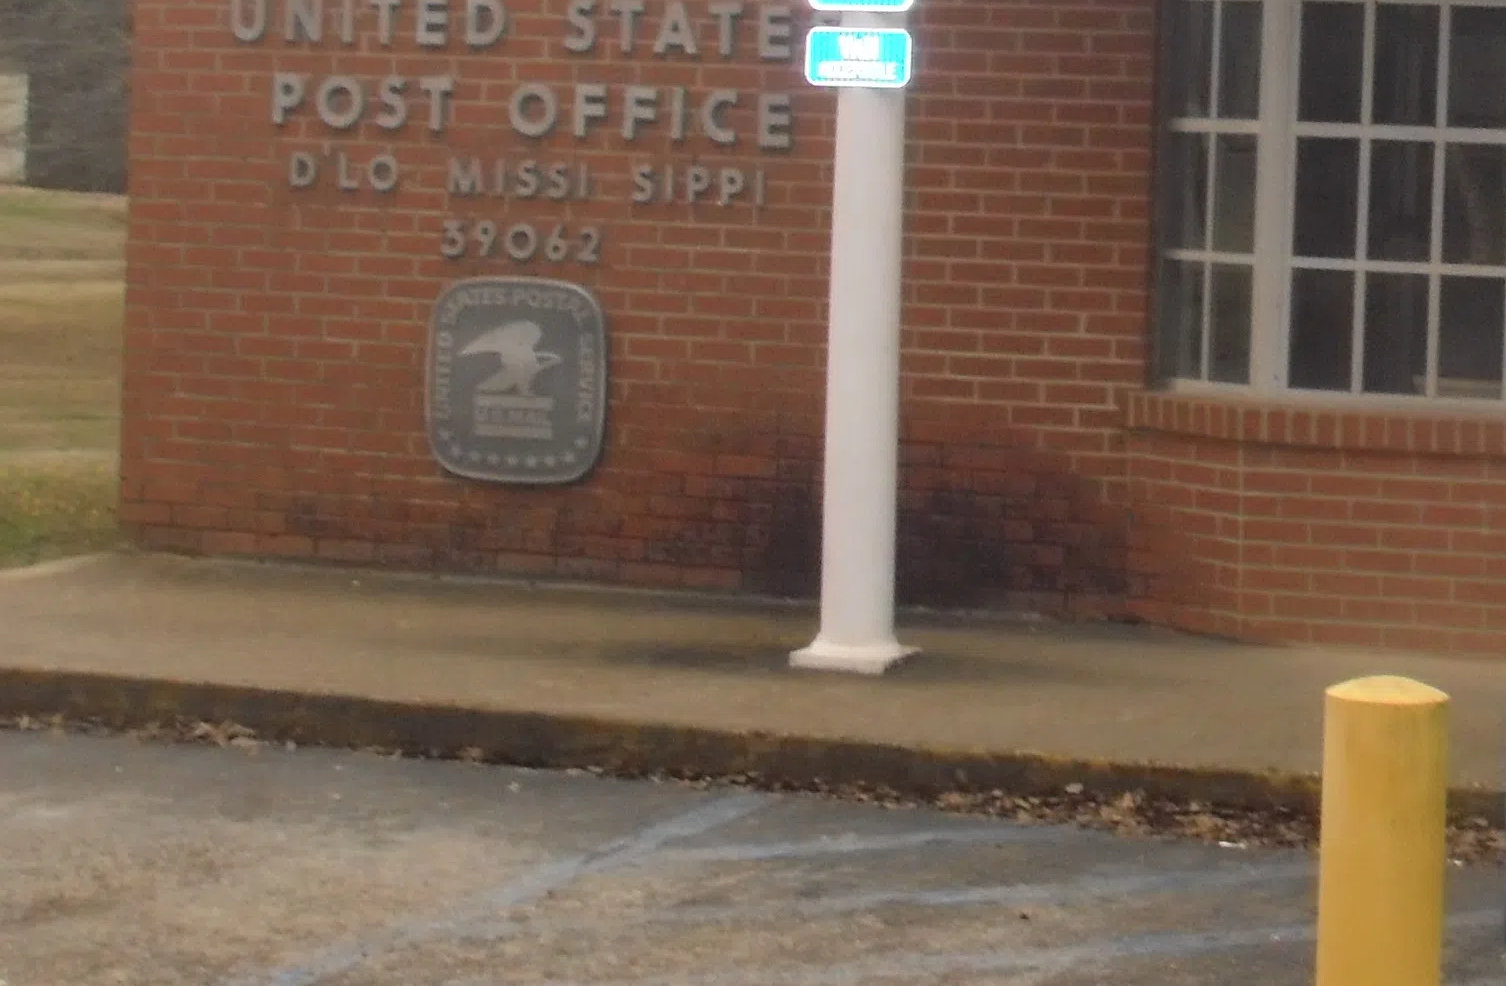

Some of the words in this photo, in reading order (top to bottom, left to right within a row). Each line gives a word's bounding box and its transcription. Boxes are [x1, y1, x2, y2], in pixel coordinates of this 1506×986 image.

[272, 73, 455, 132] POST
[509, 82, 792, 149] OFFICE
[290, 148, 398, 192] D'LO
[441, 221, 600, 262] 39062
